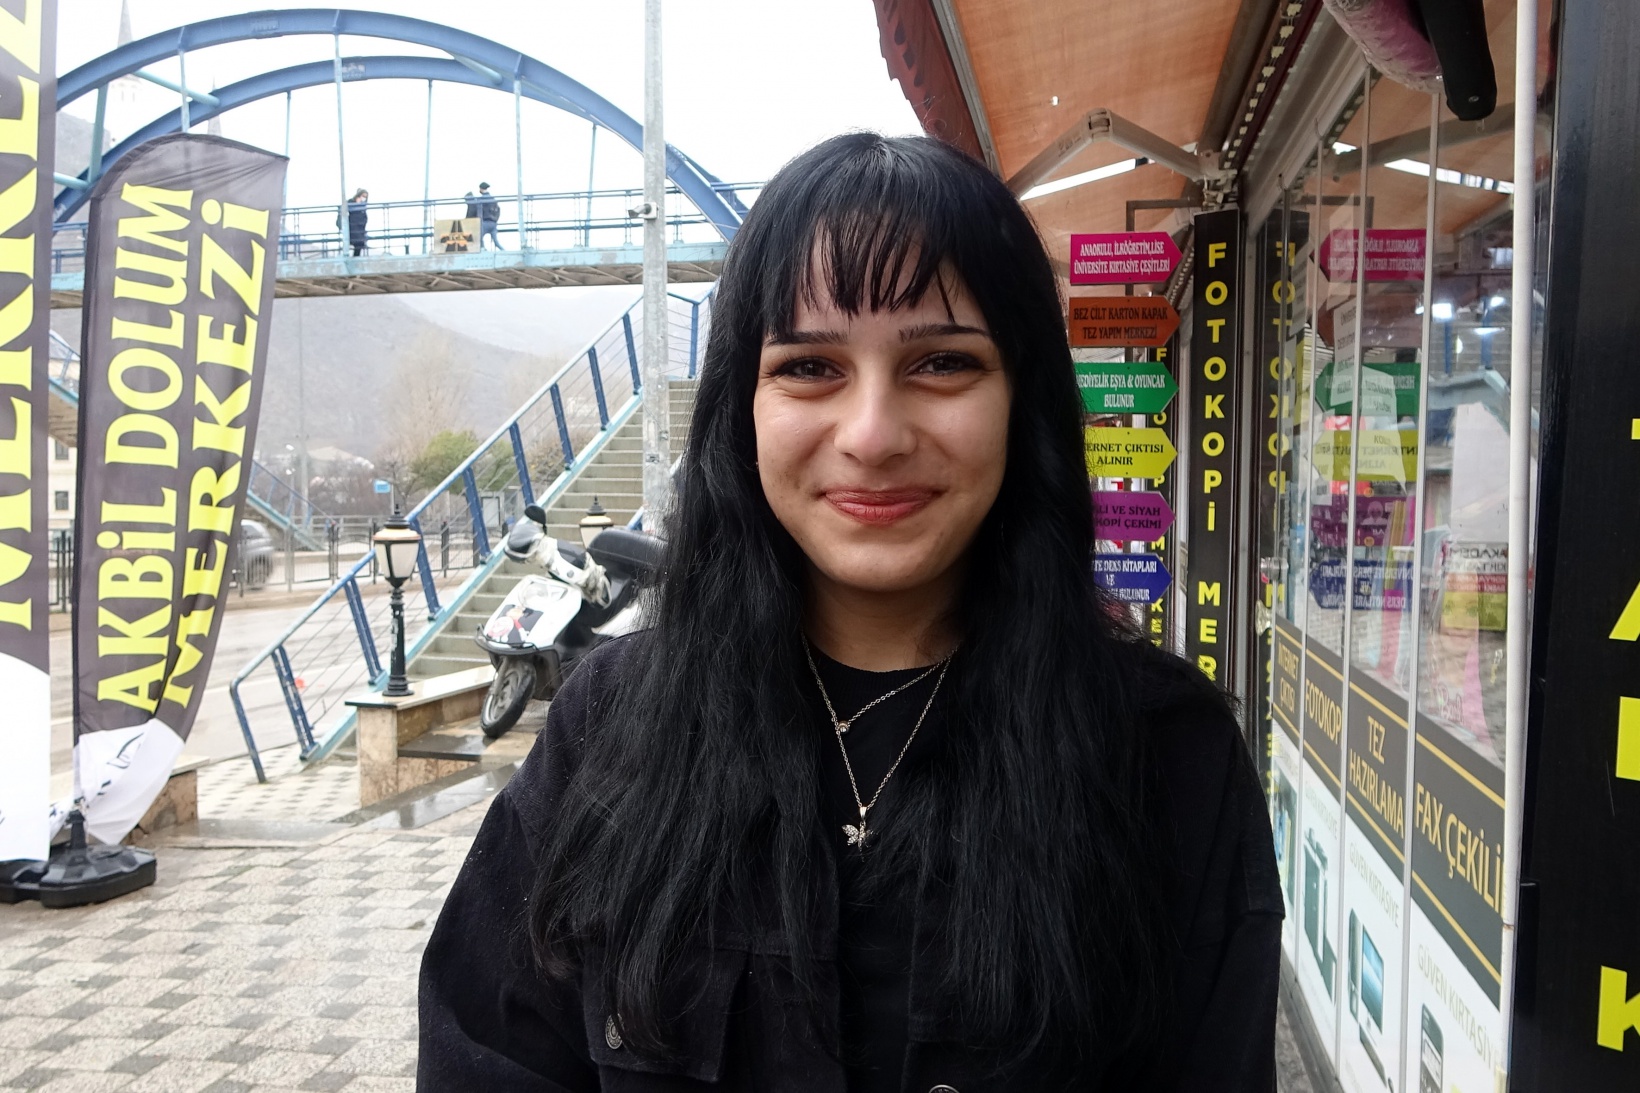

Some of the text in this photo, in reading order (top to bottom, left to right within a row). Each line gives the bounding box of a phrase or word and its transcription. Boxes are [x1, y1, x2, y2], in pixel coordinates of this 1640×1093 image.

[1074, 257, 1170, 275] ÜNİVERSİTE KIRTASİYE ÇEŞİTLERİ
[1074, 307, 1089, 320] BEZ
[1108, 307, 1139, 319] KARTON
[1141, 307, 1168, 319] KAPAK
[105, 182, 194, 469] DOLUM
[1082, 324, 1157, 339] TEZ YAPIM MERKEZİ
[1110, 374, 1126, 391] EŞYA
[1127, 374, 1134, 388] &
[1134, 374, 1165, 388] OYUNCAK
[1104, 393, 1134, 408] BULUNUR
[1085, 443, 1164, 454] ERNET ÇIKTISI
[1096, 456, 1133, 465] ALINIR
[1197, 242, 1228, 682] FOTOKOPİ MER
[1112, 505, 1126, 515] VE
[1128, 505, 1160, 516] SİYAH
[1124, 518, 1161, 530] ÇEKİMİ
[1122, 558, 1157, 573] KİTAPLARI
[1106, 573, 1115, 586] VE
[1305, 678, 1342, 745] FOTOKOP
[1367, 715, 1386, 764] TEZ
[1349, 748, 1405, 839] HAZIRLAMA
[1415, 782, 1502, 914] FAX ÇEKİLİ
[1417, 943, 1497, 1069] GÜVEN KIRTASİY
